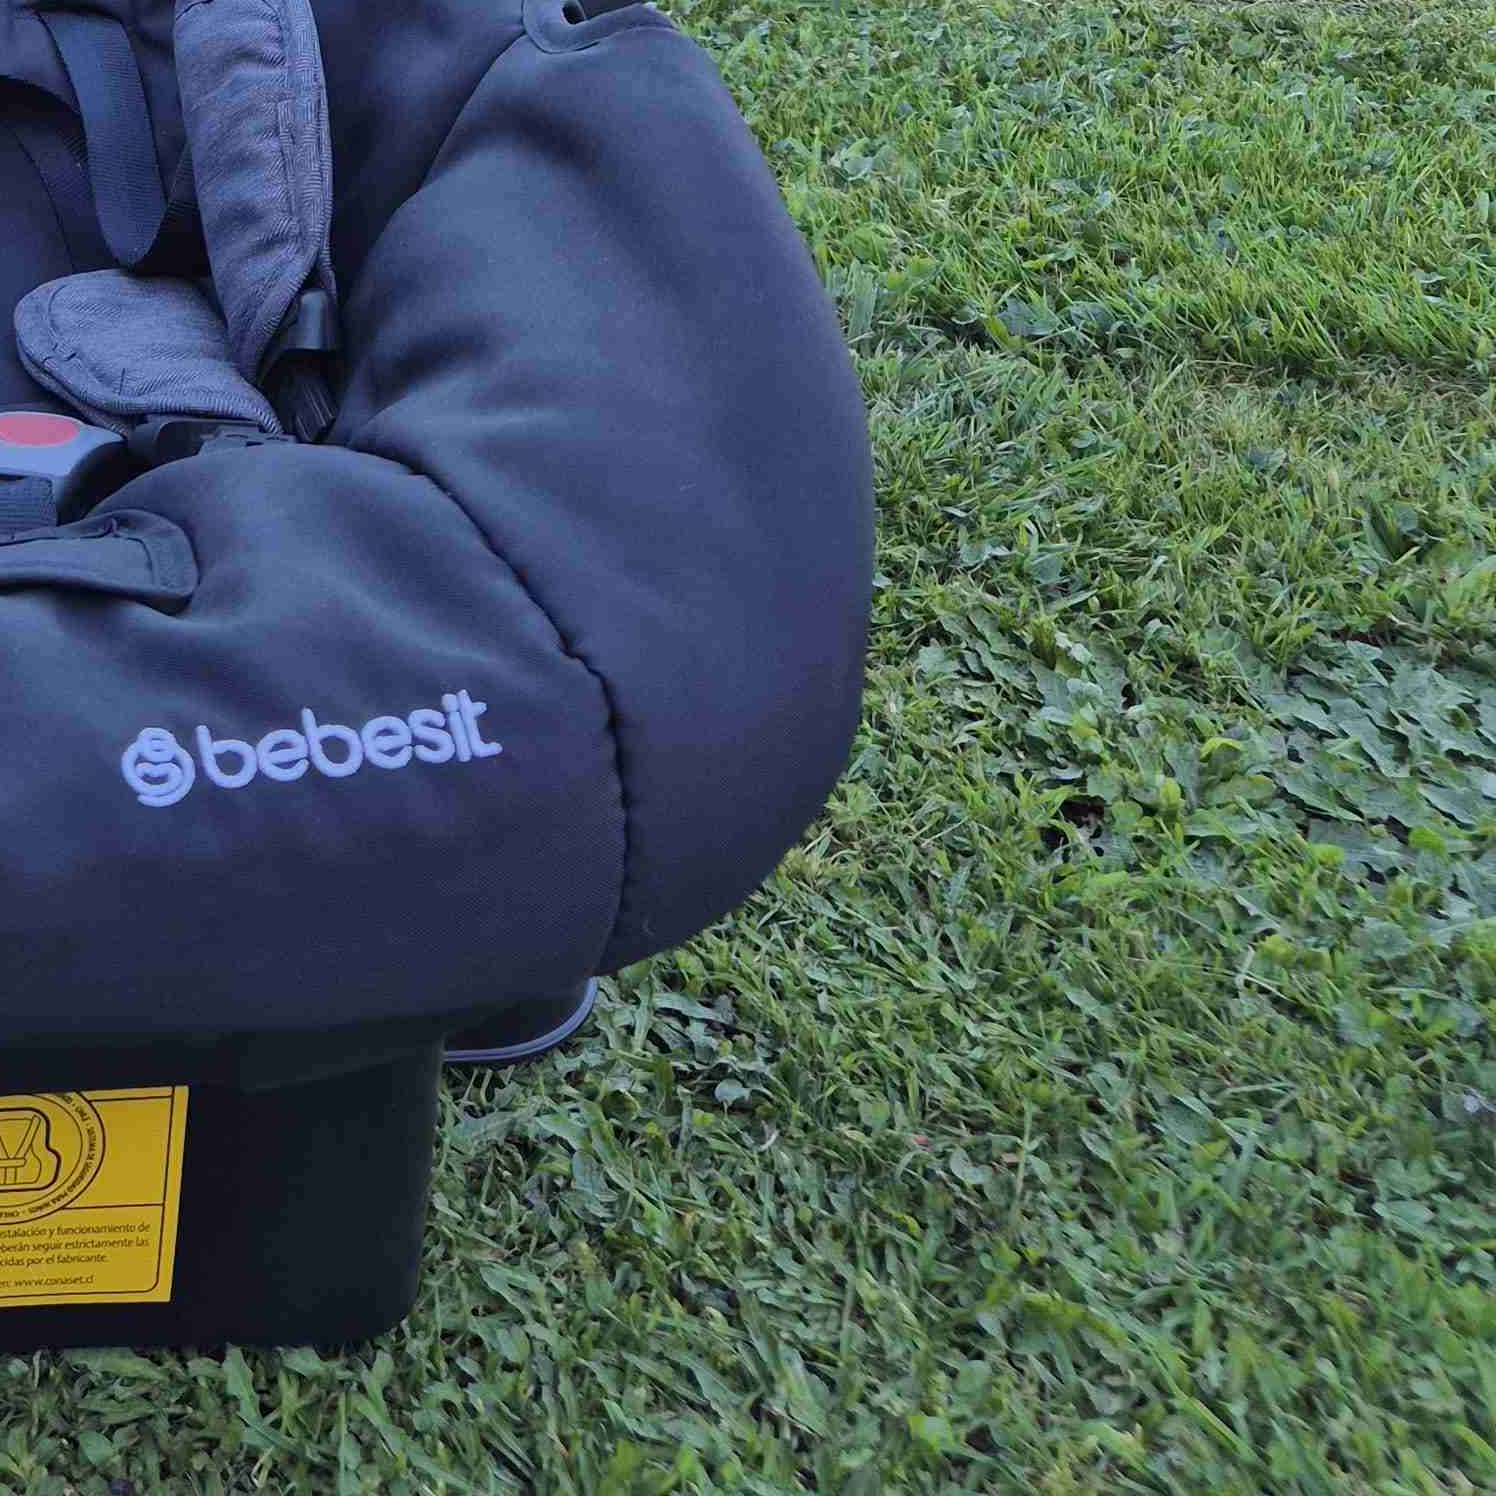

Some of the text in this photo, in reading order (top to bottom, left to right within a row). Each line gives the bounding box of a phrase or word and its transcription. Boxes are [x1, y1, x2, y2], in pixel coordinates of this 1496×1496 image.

[195, 688, 504, 790] bebesit
[56, 1223, 136, 1236] funcionamiento
[137, 1221, 151, 1233] de
[32, 1240, 65, 1254] seguir
[64, 1238, 134, 1250] estrictamente
[135, 1237, 150, 1248] las
[26, 1256, 44, 1268] por
[45, 1253, 55, 1264] el
